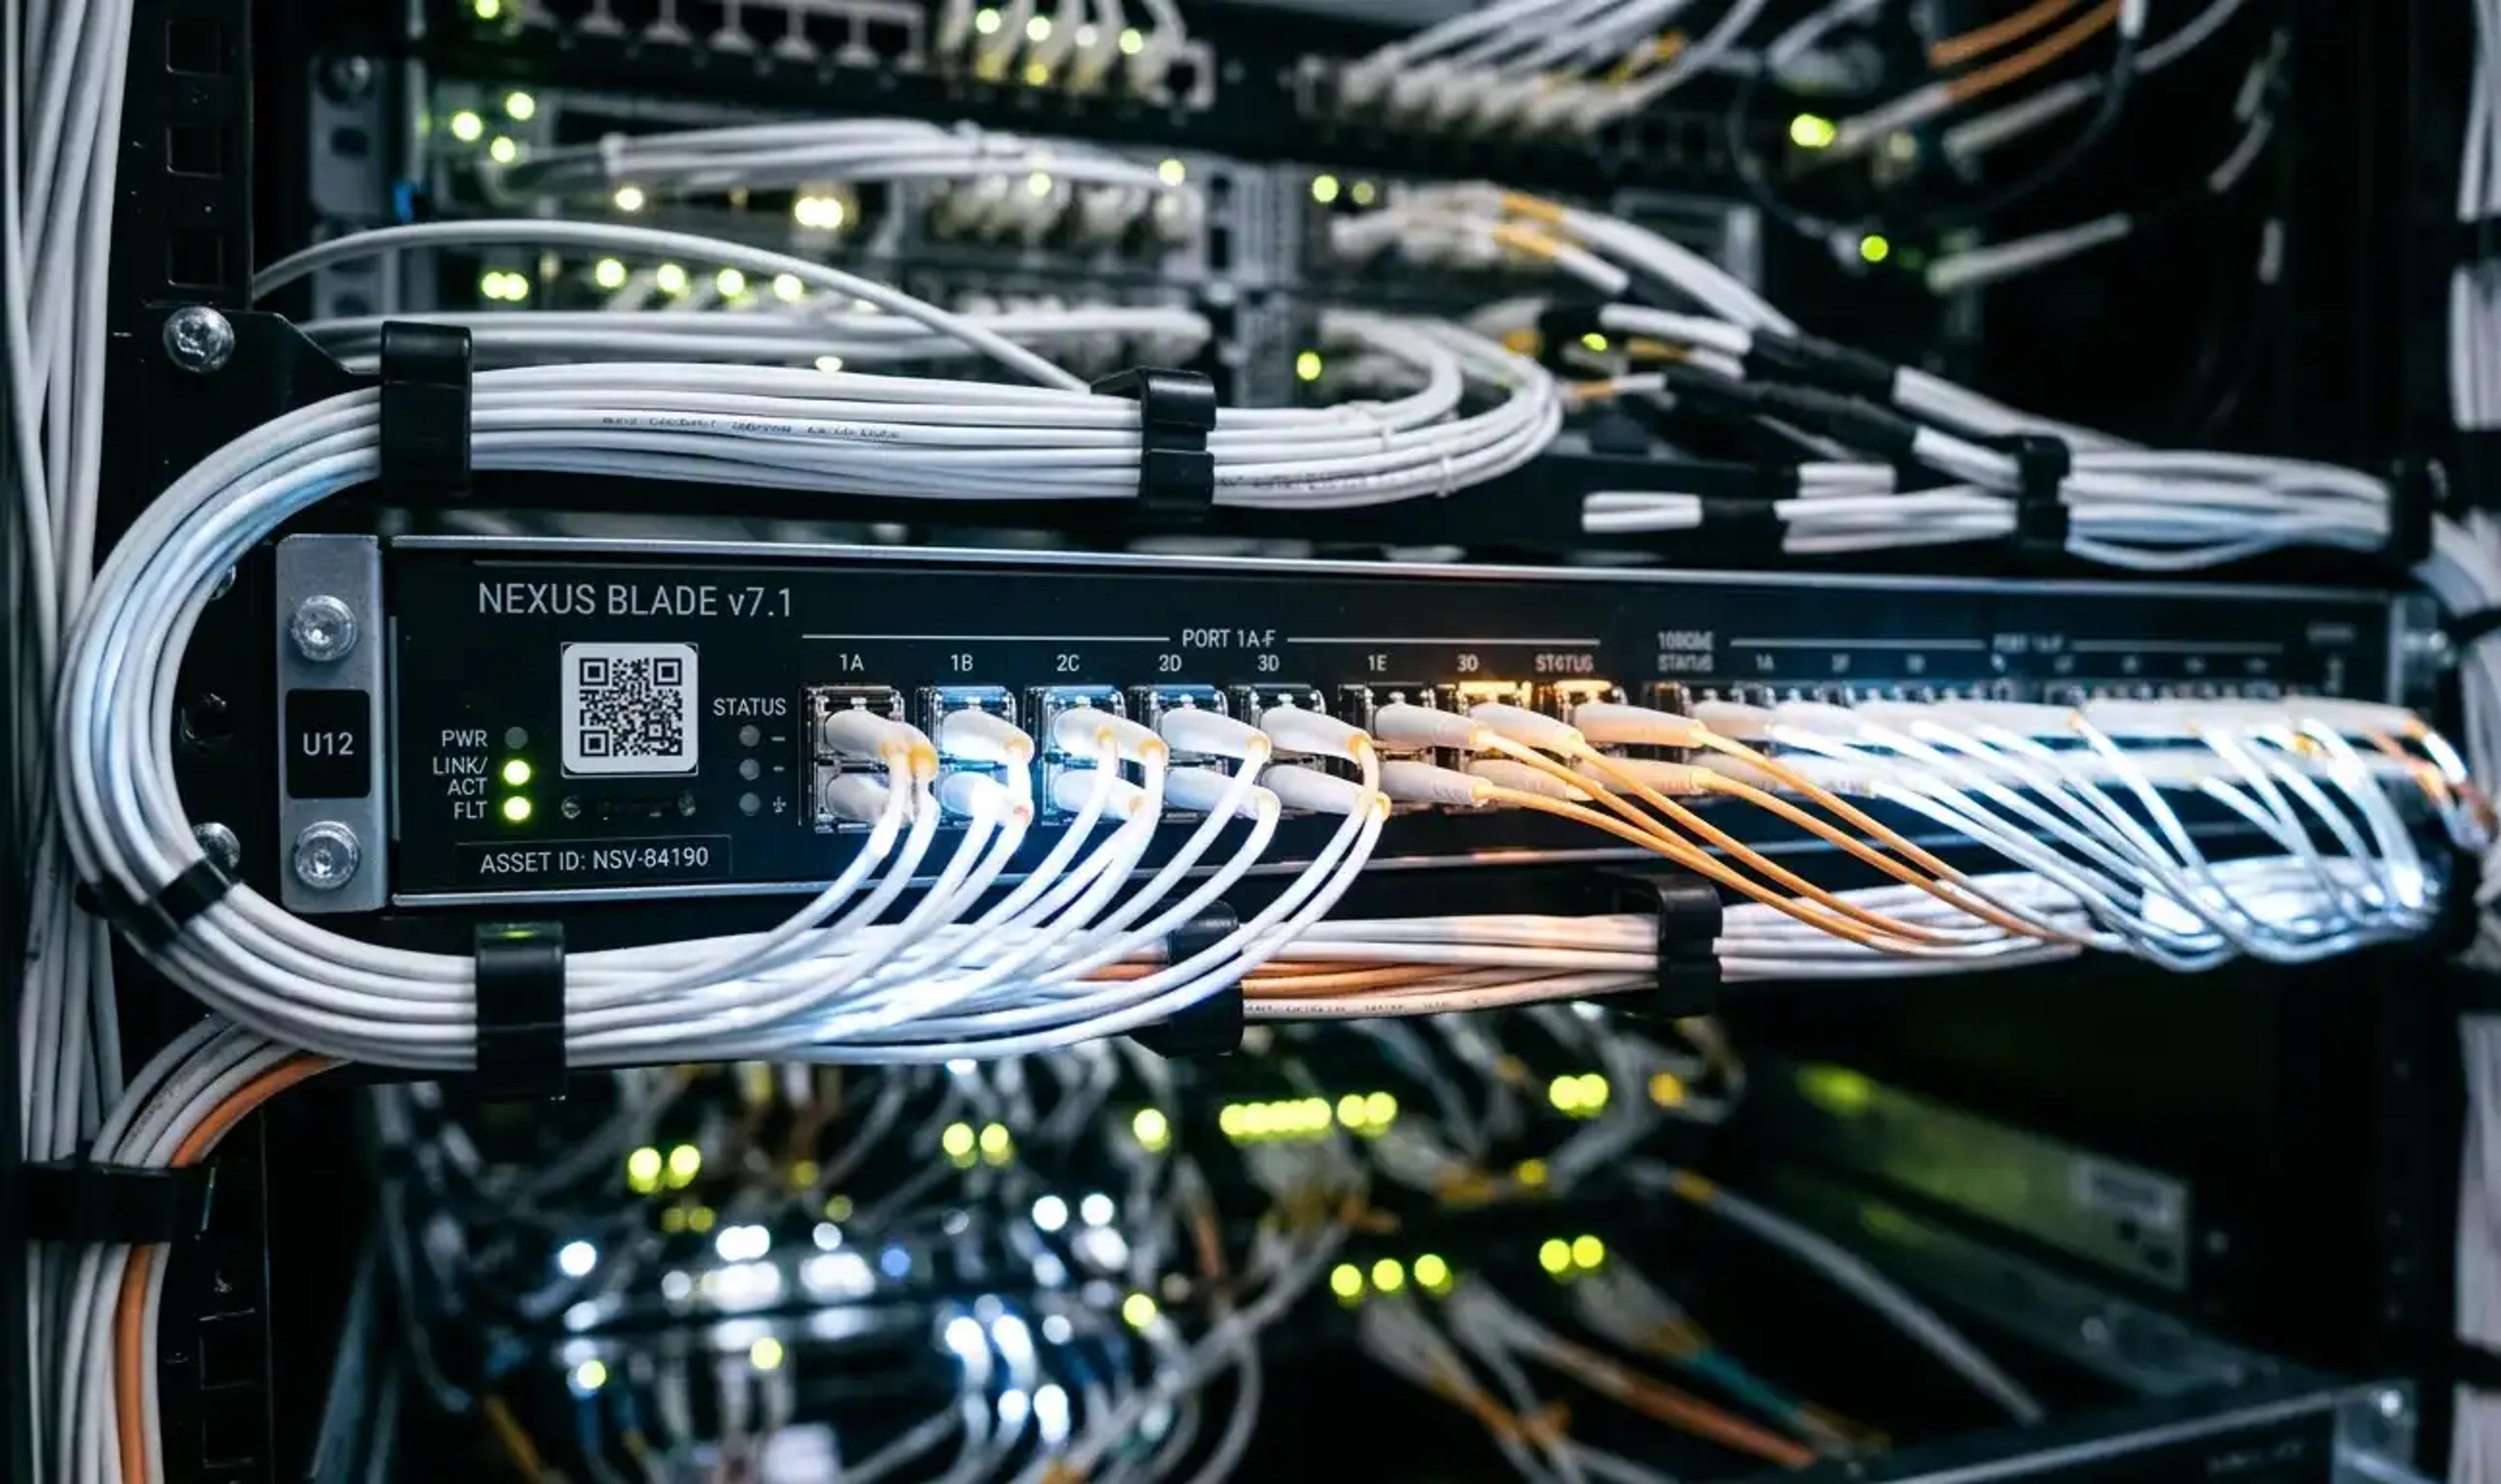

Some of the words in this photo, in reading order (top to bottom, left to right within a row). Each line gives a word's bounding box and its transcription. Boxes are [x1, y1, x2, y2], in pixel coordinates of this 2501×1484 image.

[478, 581, 596, 615] NEXUS
[607, 583, 718, 617] BLADE
[727, 586, 791, 617] v7.1
[1181, 628, 1232, 649] PORT
[839, 654, 865, 672] 1A
[950, 653, 974, 672] 1B
[1056, 653, 1081, 673] 2C
[1257, 653, 1280, 673] 3D
[1367, 654, 1387, 672] 1E
[713, 697, 787, 717] STATUS
[302, 731, 354, 757] U12
[441, 729, 488, 748] PWR
[432, 756, 488, 776] LINK/
[447, 777, 488, 796] ACT
[453, 800, 488, 820] FLT
[479, 851, 552, 875] ASSET
[558, 850, 586, 871] ID:
[593, 846, 709, 870] NSV-84190
